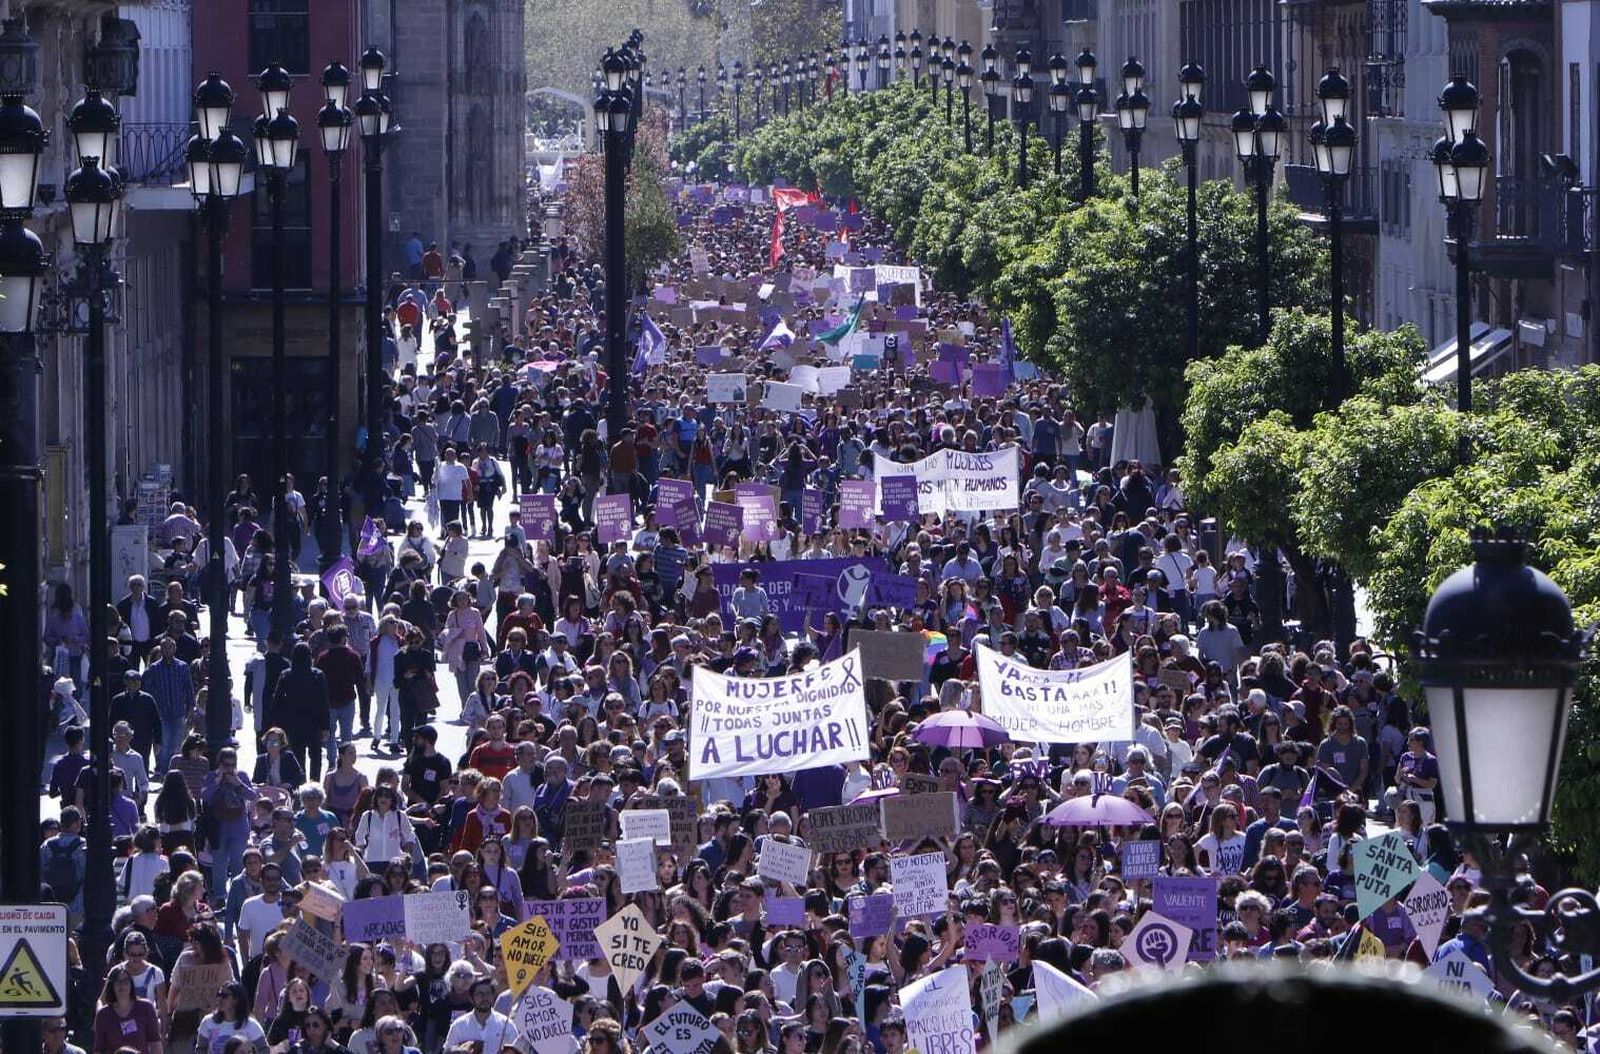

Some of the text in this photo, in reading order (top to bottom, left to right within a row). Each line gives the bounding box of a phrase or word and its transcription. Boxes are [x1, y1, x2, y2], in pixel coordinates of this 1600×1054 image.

[946, 452, 994, 471] MUJERES
[965, 477, 1007, 491] HUMANOS
[696, 700, 721, 713] POR
[796, 683, 855, 703] DIGNIDAD
[1001, 681, 1067, 701] BASTA
[772, 704, 832, 726] JUNTAS
[1048, 704, 1070, 714] UNA
[1059, 716, 1116, 733] HOMBRE
[701, 737, 721, 764] A
[1130, 843, 1154, 854] VIVAS
[1382, 834, 1398, 849] NI
[1127, 854, 1156, 864] LIBRES
[1366, 845, 1412, 874] SANTA
[1124, 864, 1158, 876] IGUALES
[1371, 864, 1389, 879] NI
[1357, 873, 1391, 898] PUTA
[528, 901, 602, 915] VESTIR SEXY
[904, 900, 936, 914] GRITAR
[1406, 890, 1447, 916] SORORIDAD
[3, 925, 12, 933] EN
[25, 925, 65, 933] PAVIMENTO
[569, 917, 600, 930] GUSTO
[621, 916, 638, 931] YO
[511, 936, 545, 952] AMOR
[566, 945, 596, 957] TOCAR
[611, 935, 651, 954] SI TE
[507, 949, 522, 961] NO
[523, 952, 546, 966] DUELE
[612, 953, 644, 971] CREO
[1447, 961, 1465, 977] NI
[525, 1008, 560, 1027] AMOR
[654, 1012, 710, 1036] EL FUTURO
[527, 1020, 570, 1042] NO DUELE
[676, 1029, 691, 1040] ES
